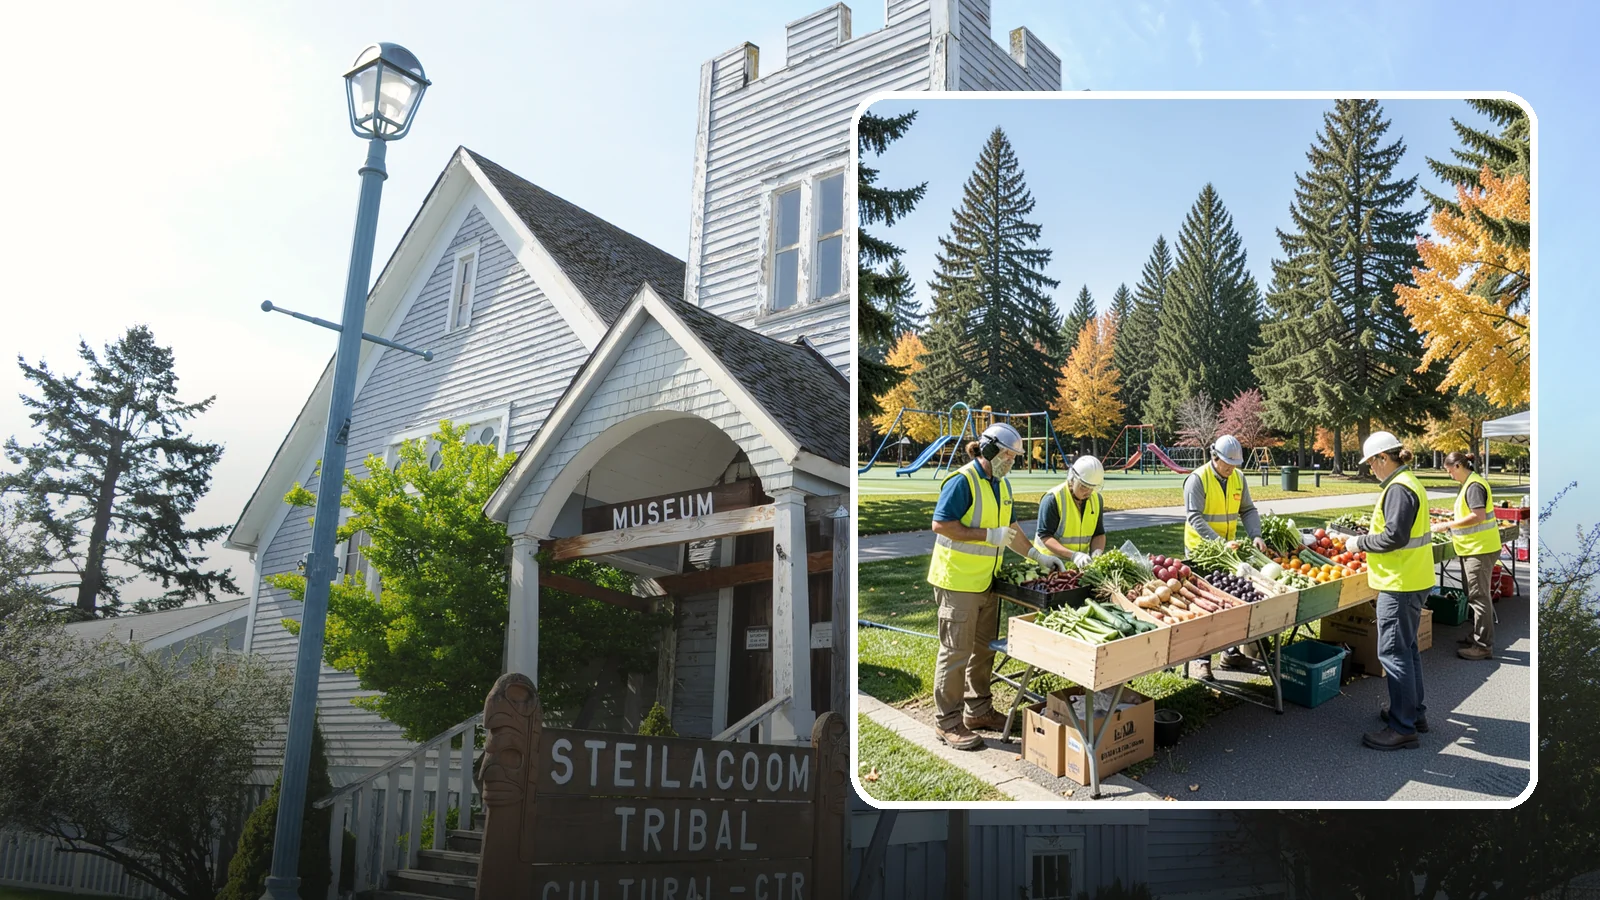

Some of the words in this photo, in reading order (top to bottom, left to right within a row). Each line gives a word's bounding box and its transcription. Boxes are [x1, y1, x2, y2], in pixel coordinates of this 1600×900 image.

[613, 491, 713, 531] MUSEUM
[550, 738, 810, 793] STEILACOOM
[614, 806, 758, 852] TRIBAL
